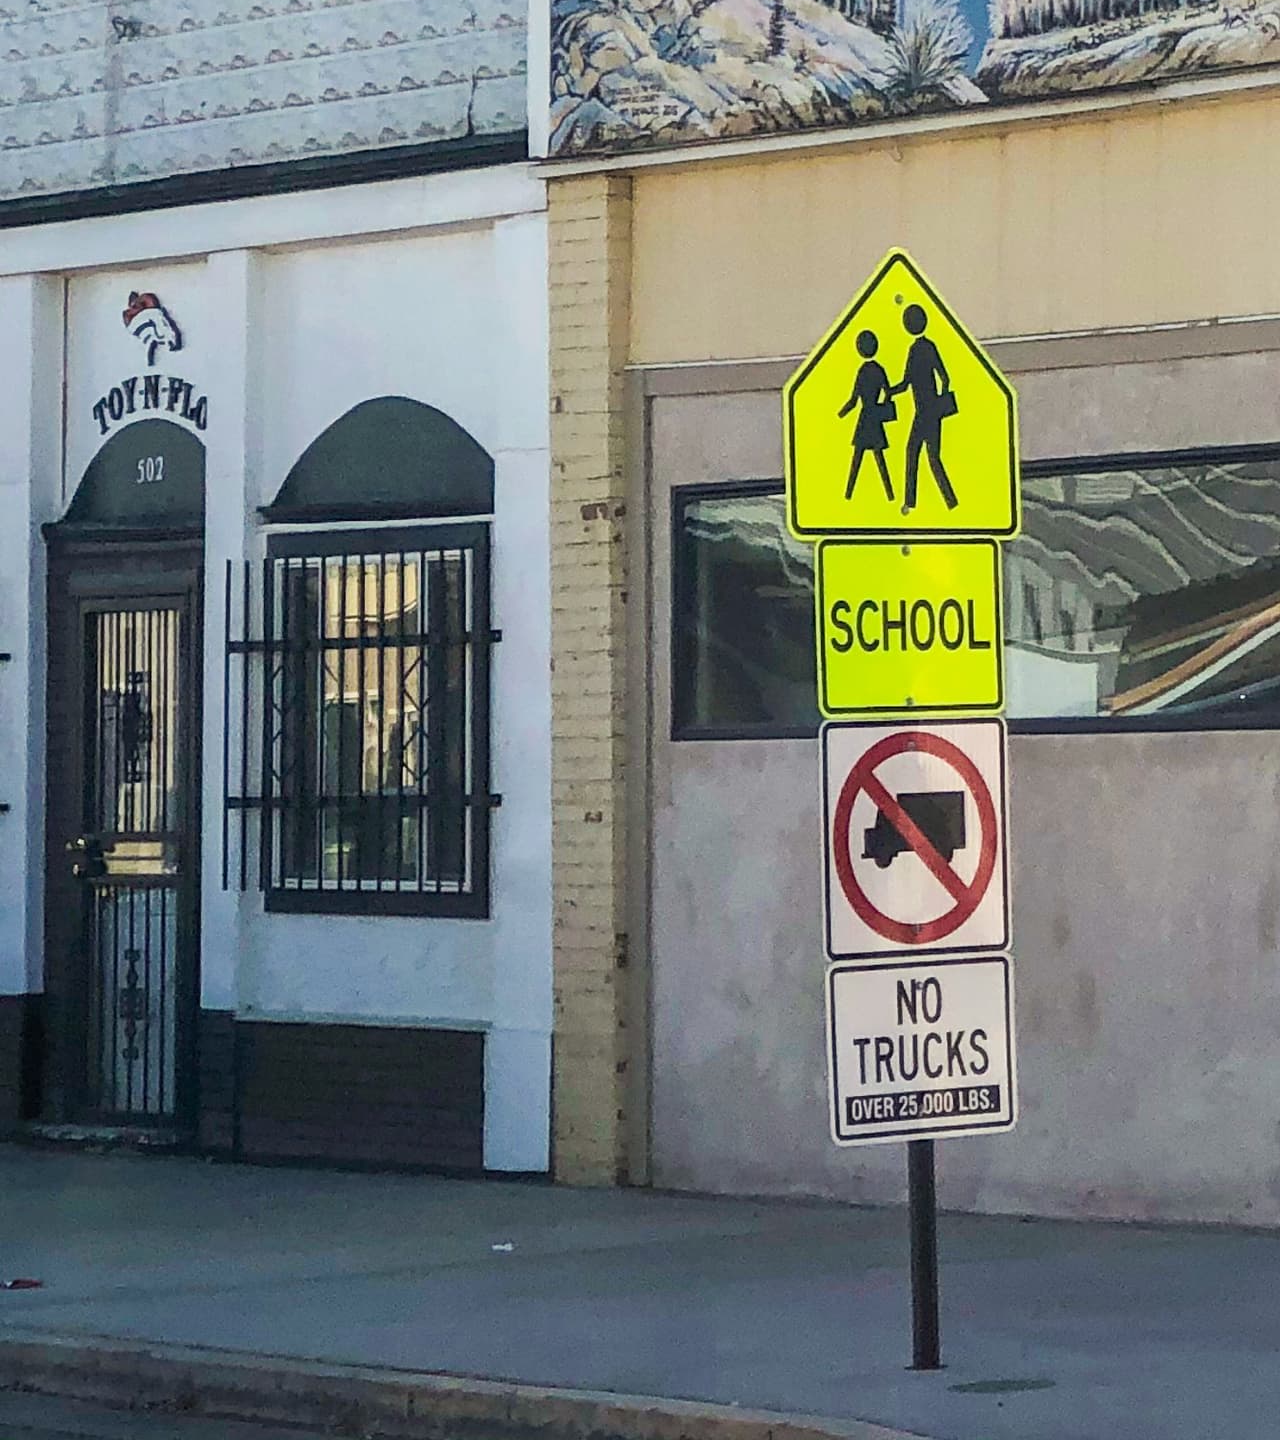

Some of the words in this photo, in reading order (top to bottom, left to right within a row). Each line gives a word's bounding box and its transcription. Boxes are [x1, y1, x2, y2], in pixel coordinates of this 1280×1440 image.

[136, 455, 165, 484] 502
[830, 598, 992, 653] SCHOOL
[896, 976, 943, 1026] NO
[852, 1028, 990, 1085] TRUCKS
[851, 1095, 895, 1122] OVER
[898, 1090, 954, 1117] 25,000
[958, 1088, 995, 1112] LBS.
